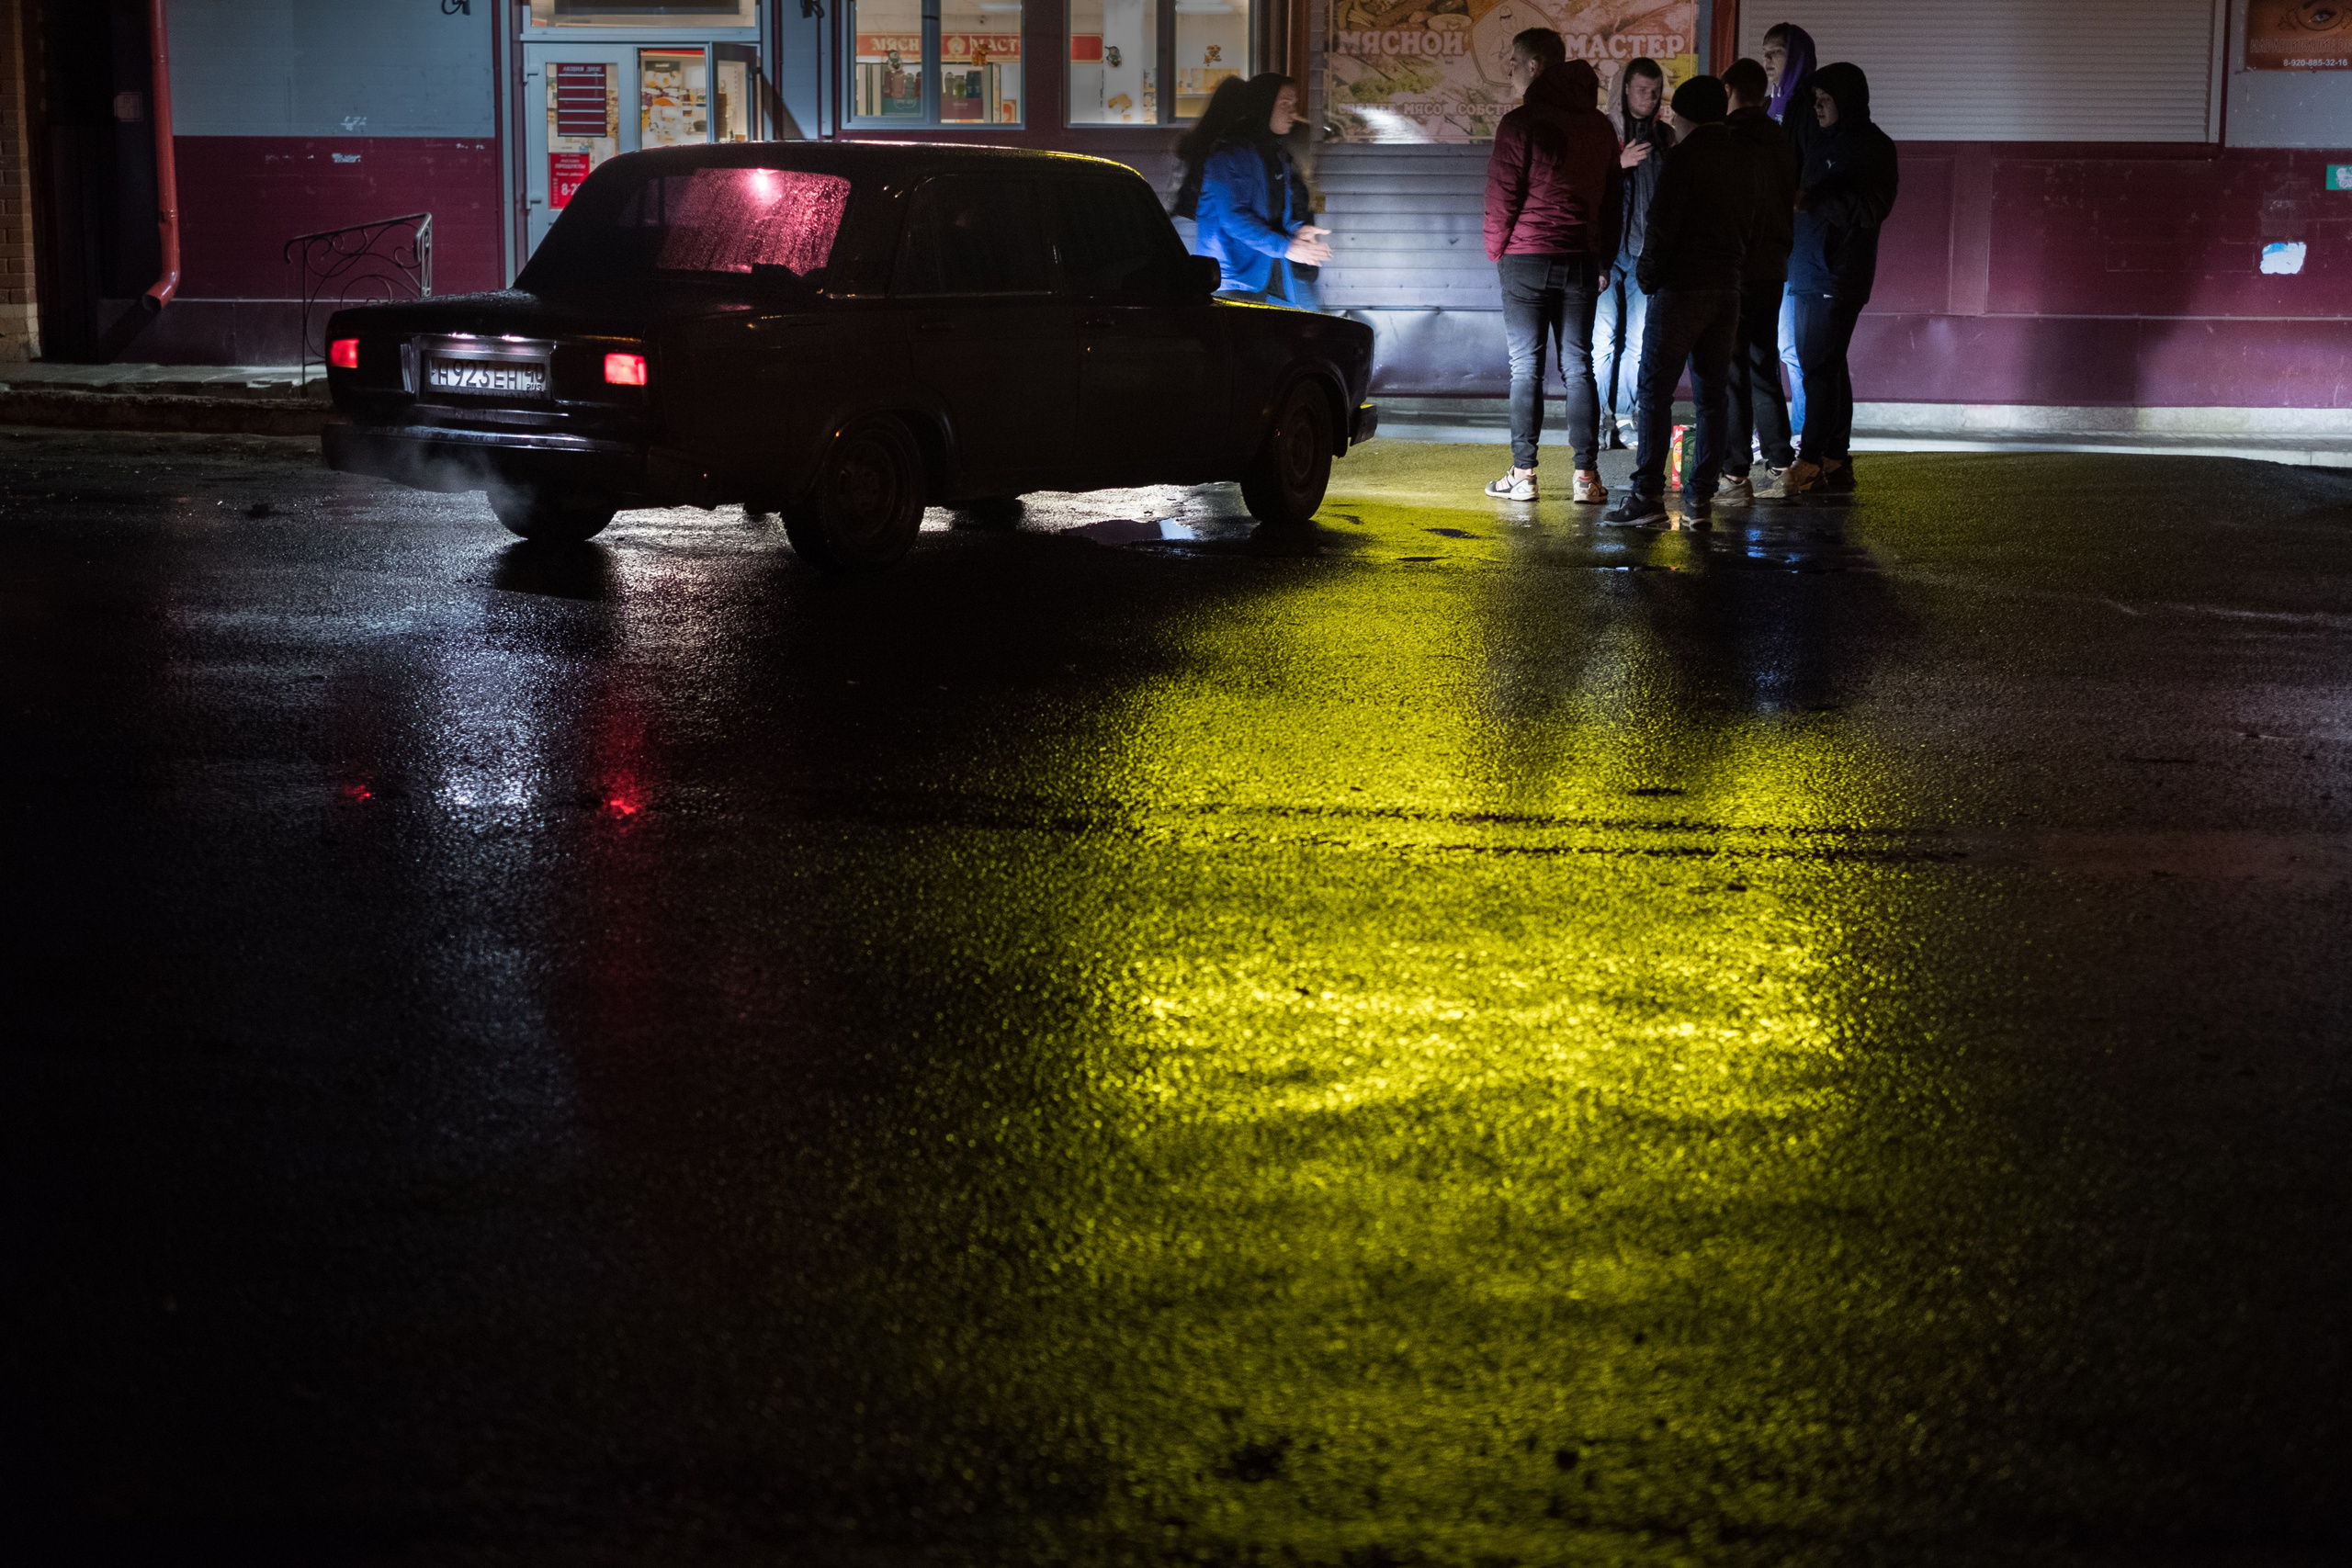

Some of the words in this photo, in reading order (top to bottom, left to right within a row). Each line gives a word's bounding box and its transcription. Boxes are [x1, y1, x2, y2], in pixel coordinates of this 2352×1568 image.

[1338, 25, 1464, 55] МЯСНОЙ
[1565, 33, 1685, 59] МАСТЕР
[2283, 59, 2348, 67] 8-920-885-32-16
[1403, 103, 1442, 116] МЯСО
[1457, 103, 1519, 116] СОБСТВ
[561, 183, 582, 196] 8-2
[526, 383, 542, 392] RUS
